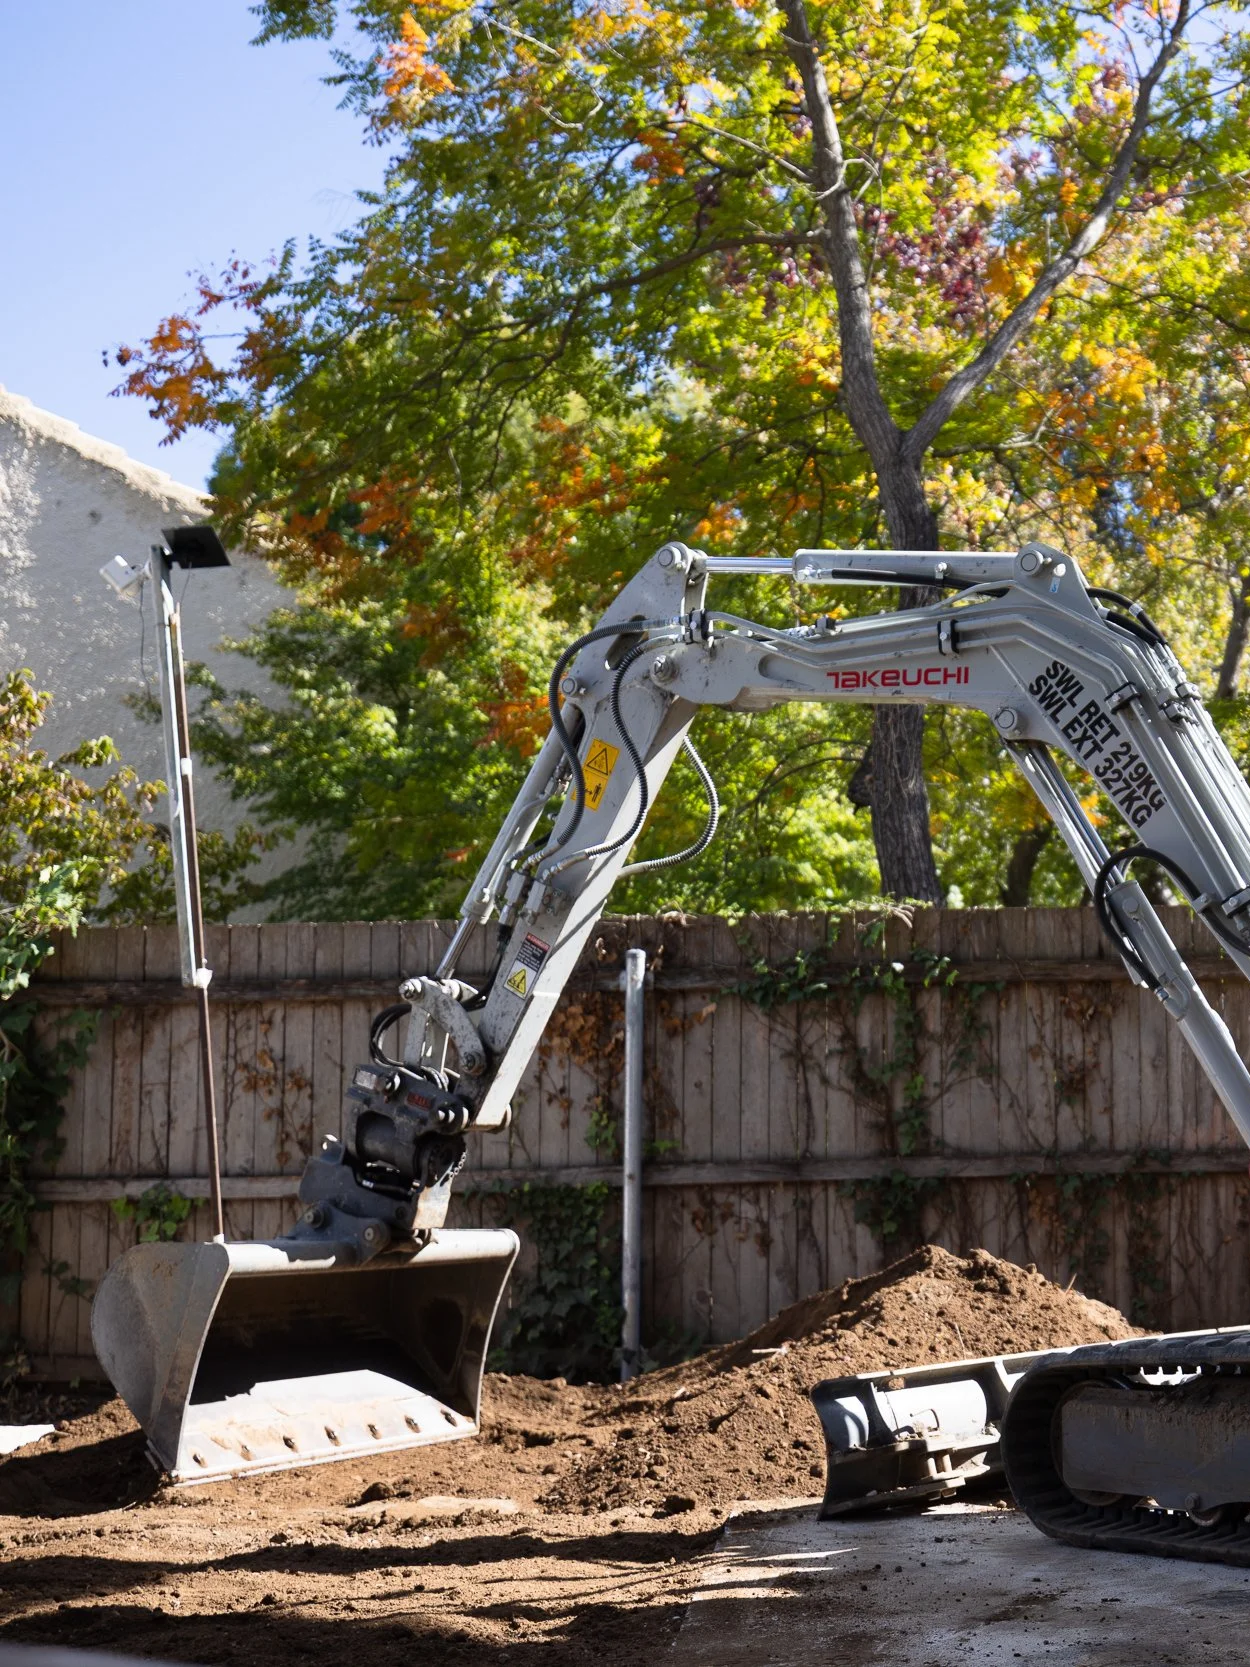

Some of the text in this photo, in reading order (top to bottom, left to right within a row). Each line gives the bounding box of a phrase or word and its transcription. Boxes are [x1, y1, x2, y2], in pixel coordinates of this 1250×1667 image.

[1028, 674, 1153, 829] SWL EXT 327KG
[1046, 660, 1167, 812] SWL RET 219KG
